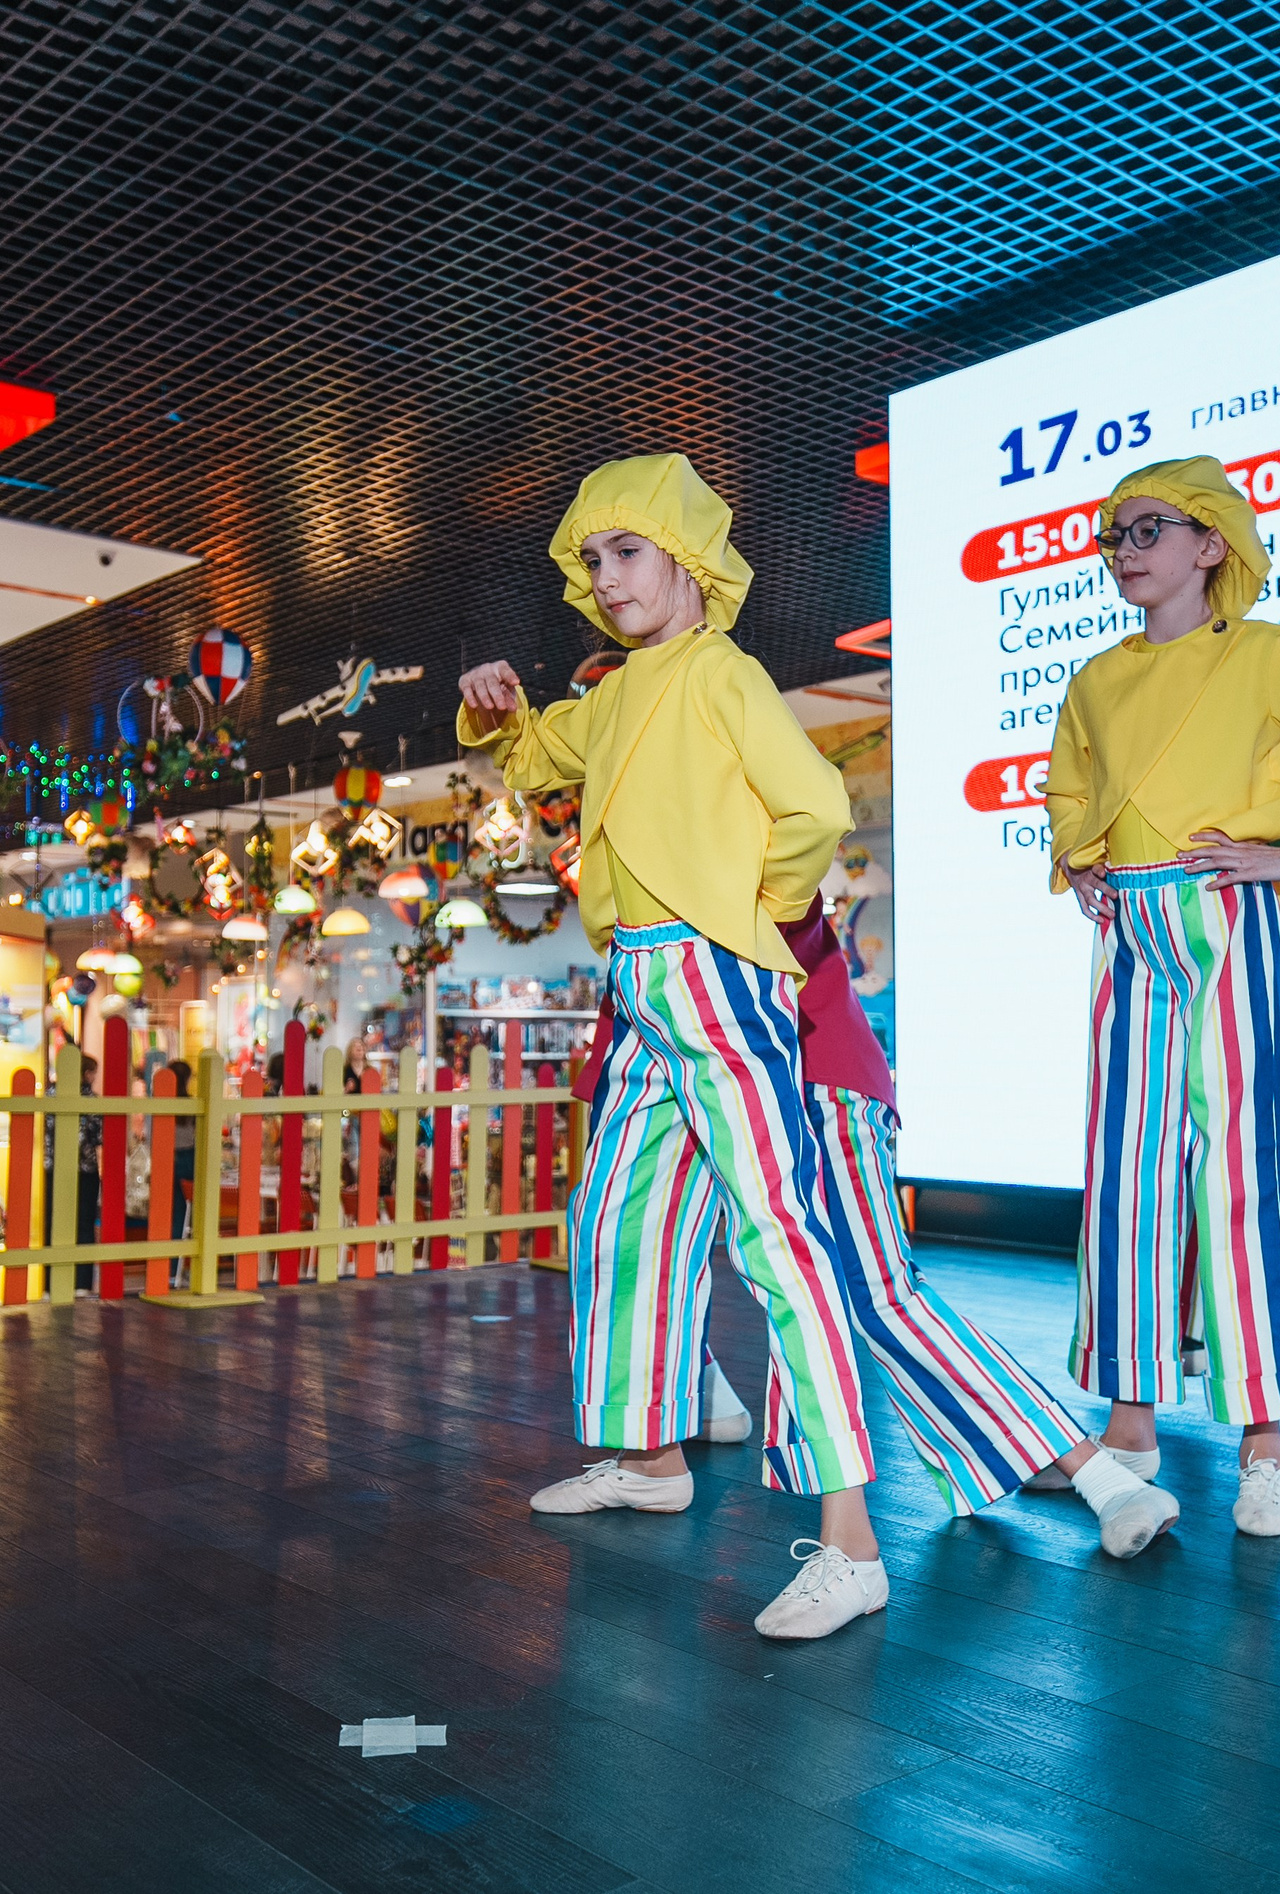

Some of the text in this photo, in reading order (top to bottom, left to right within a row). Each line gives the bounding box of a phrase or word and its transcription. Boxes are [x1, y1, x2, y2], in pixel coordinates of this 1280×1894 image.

[999, 409, 1151, 487] 17.03
[1000, 566, 1104, 622] Гуляй!
[1000, 603, 1143, 653] Семейн
[1000, 657, 1093, 697] прог
[999, 759, 1051, 804] 16
[1003, 820, 1054, 852] Гор
